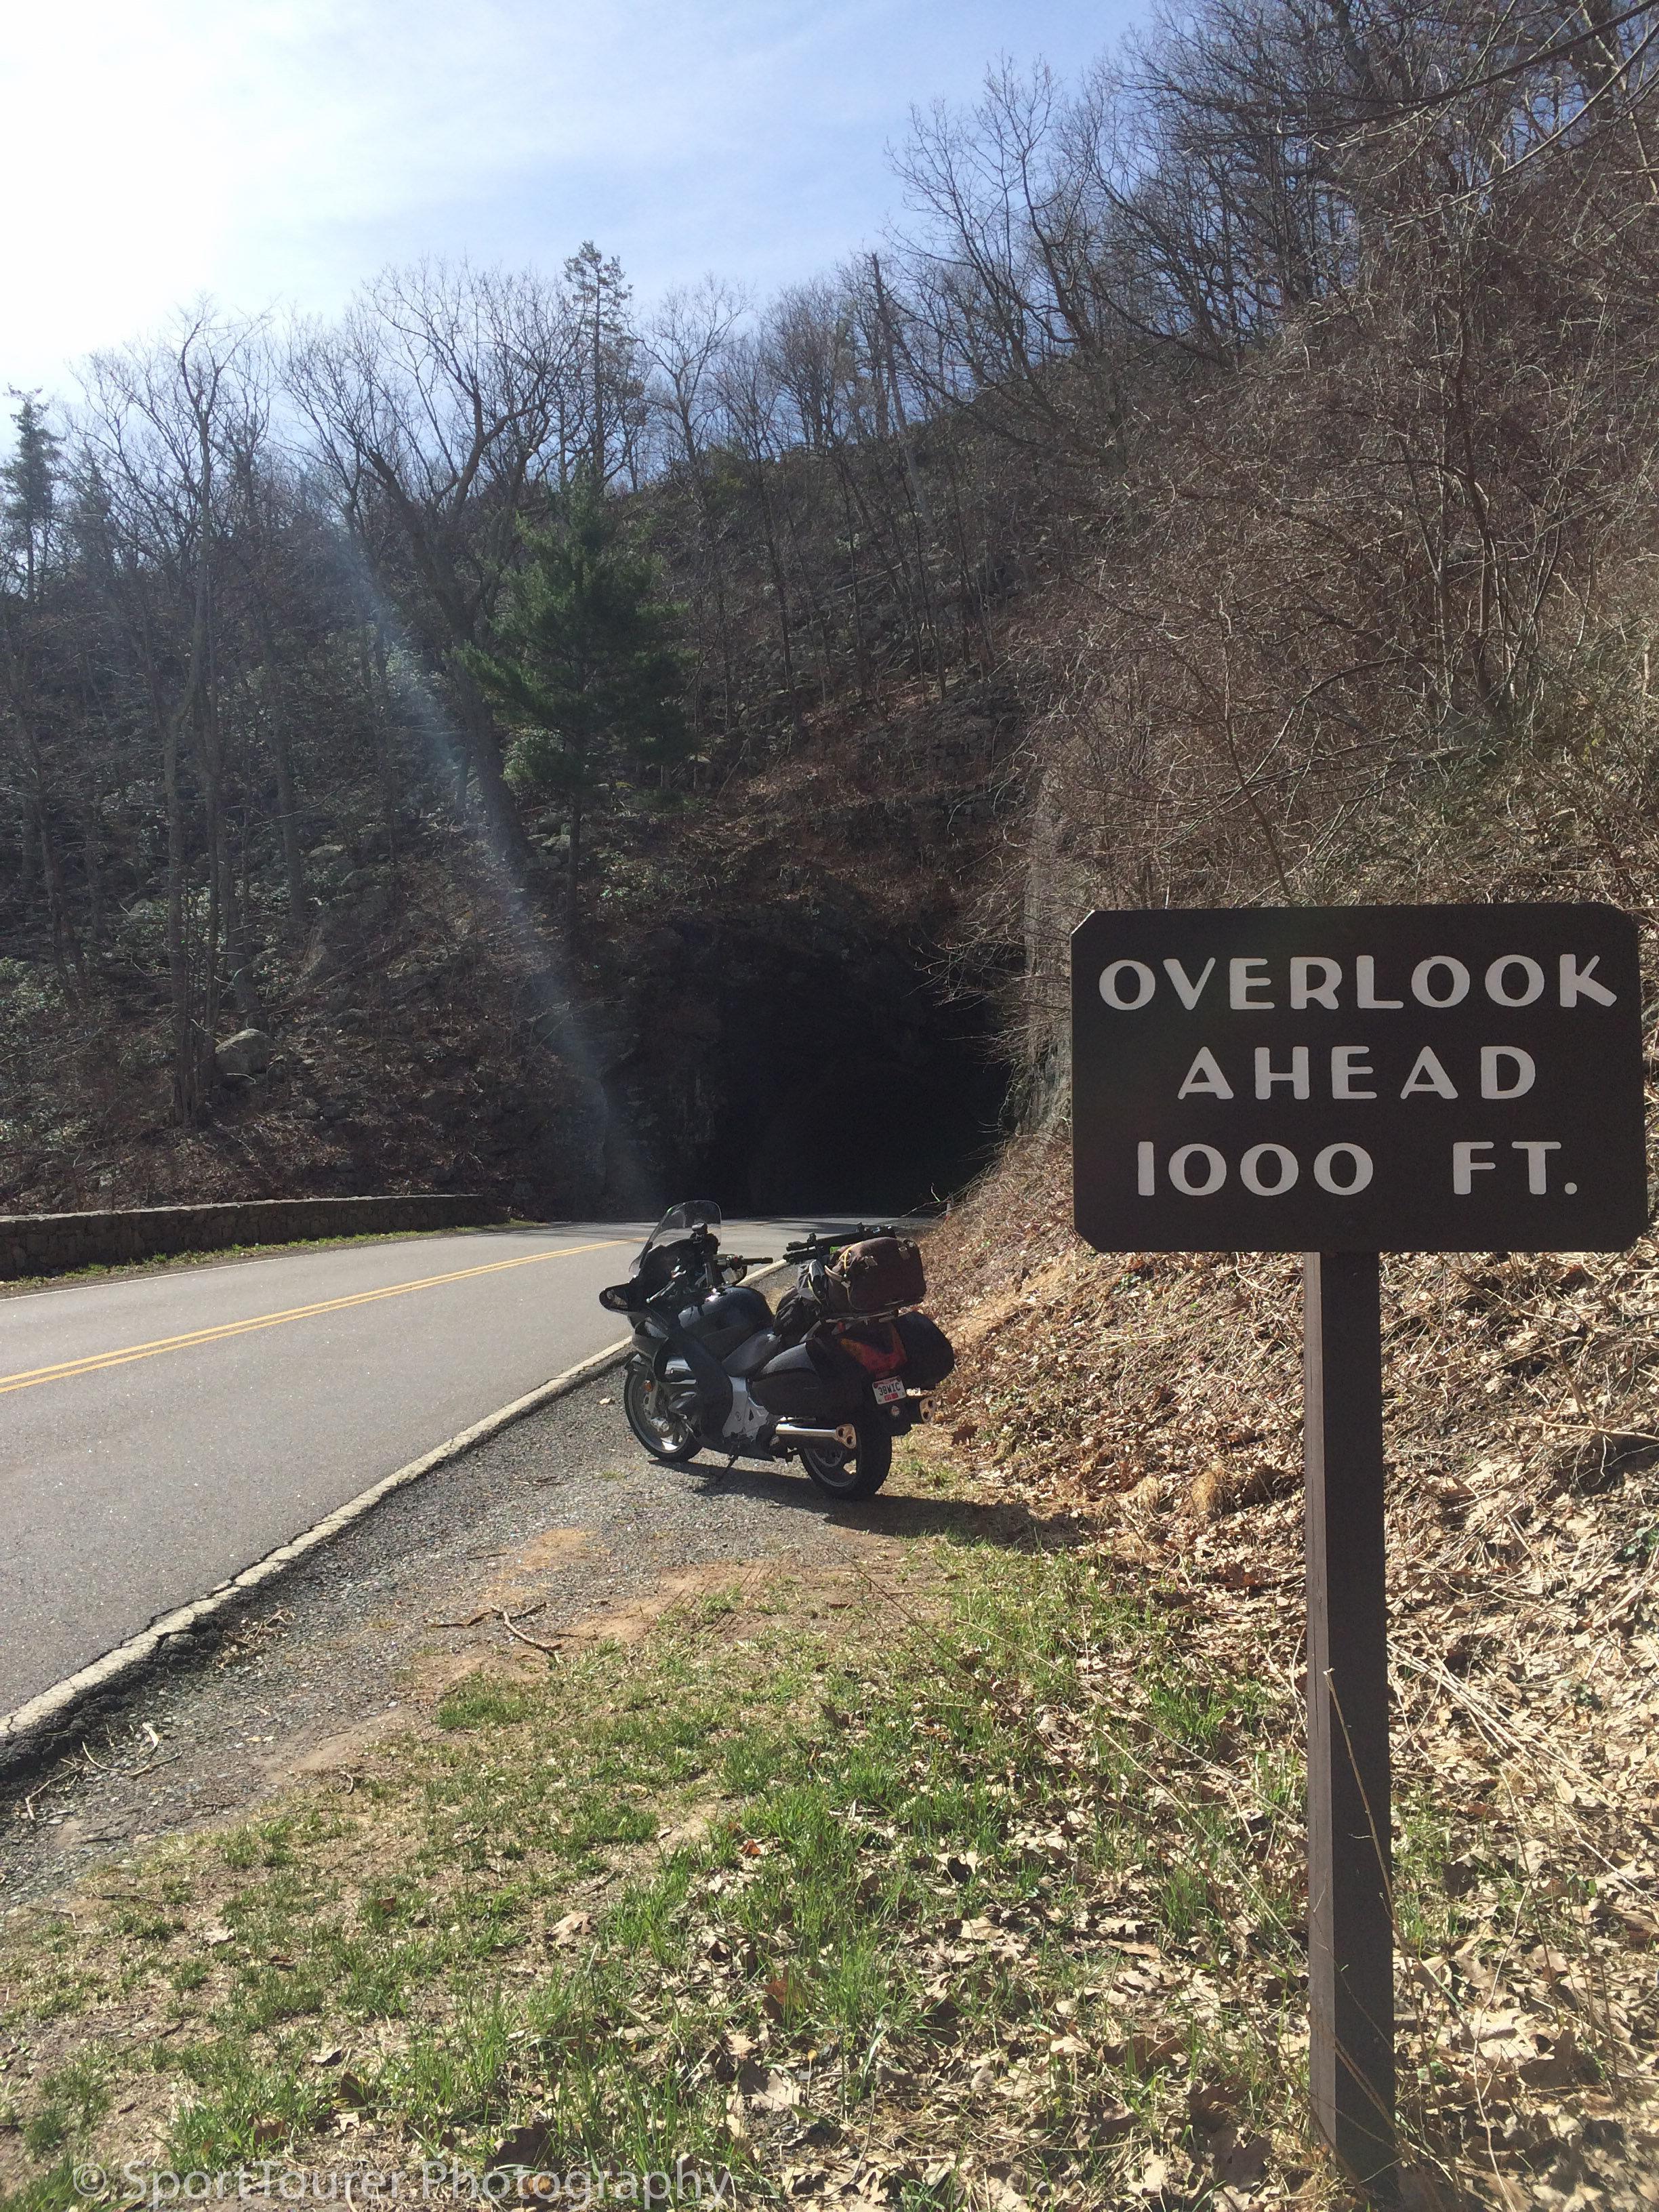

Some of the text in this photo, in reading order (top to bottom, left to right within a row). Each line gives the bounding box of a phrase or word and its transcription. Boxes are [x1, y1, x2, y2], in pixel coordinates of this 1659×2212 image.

[1099, 954, 1618, 1010] OVERLOOK
[1177, 1046, 1536, 1100] AHEAD
[1137, 1141, 1578, 1197] 1000 FT.
